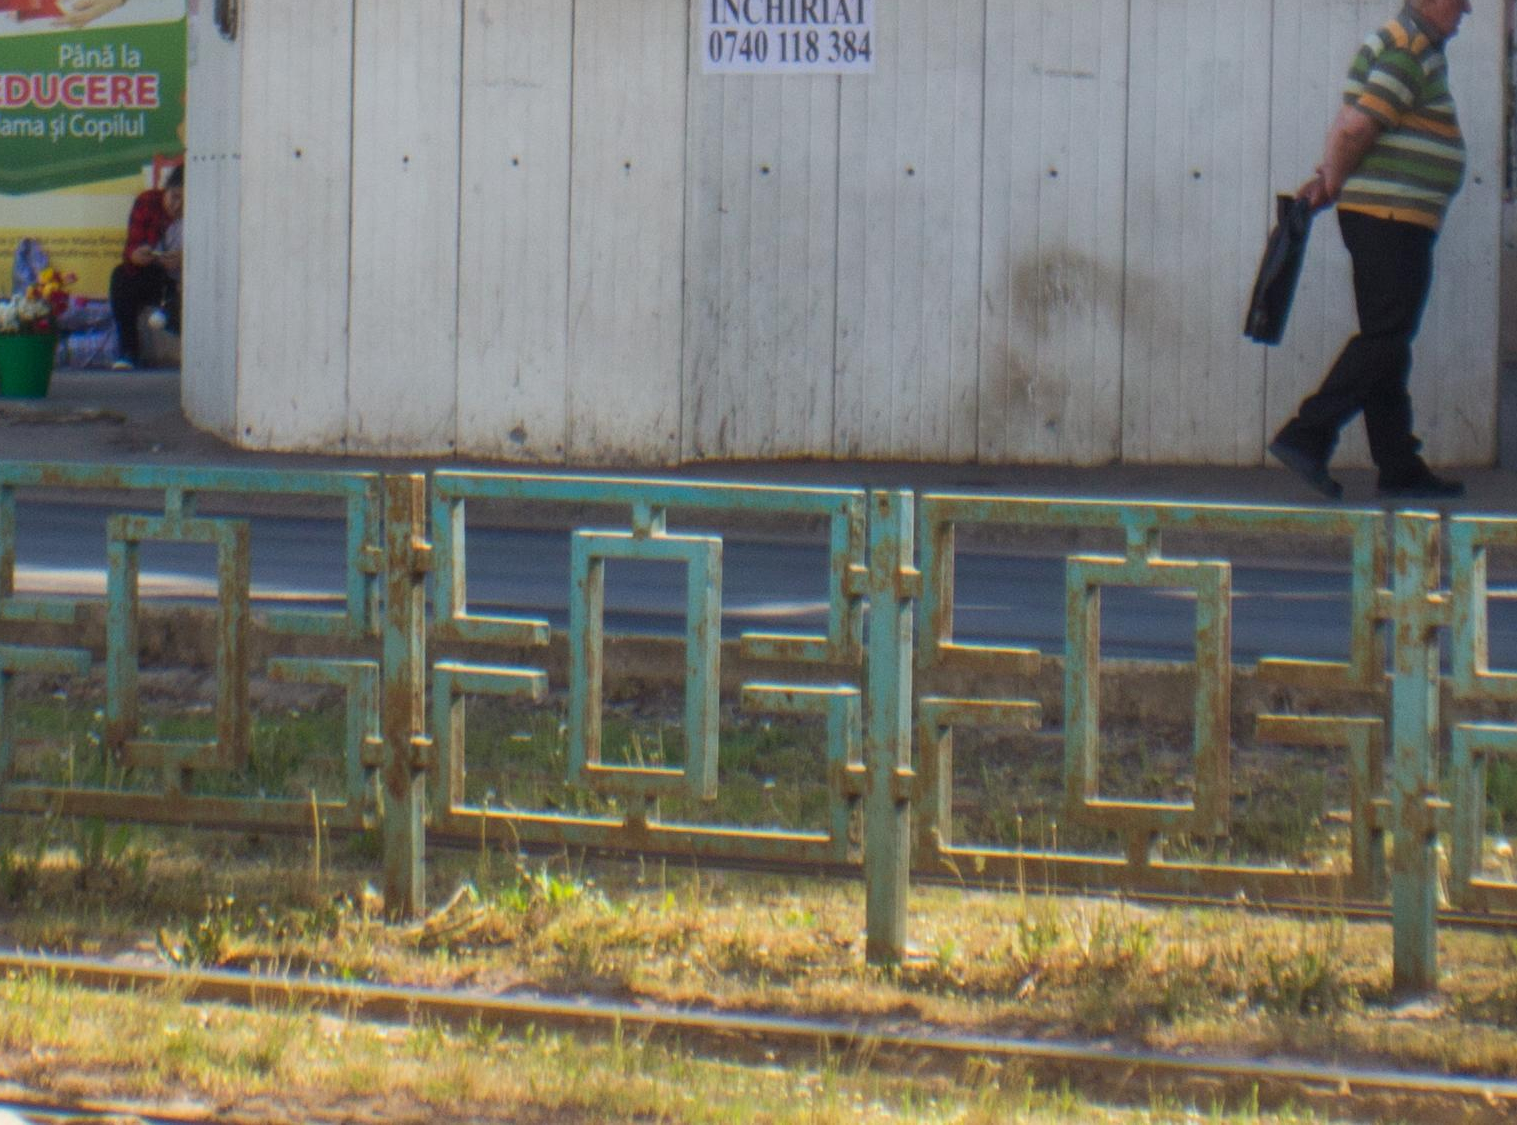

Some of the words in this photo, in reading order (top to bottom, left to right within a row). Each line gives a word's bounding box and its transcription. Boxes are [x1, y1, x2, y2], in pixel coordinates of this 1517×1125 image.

[59, 42, 115, 69] Până
[120, 44, 142, 69] la
[709, 30, 768, 63] 0740
[779, 30, 819, 63] 118
[828, 30, 872, 63] 384
[50, 114, 66, 142] și
[70, 114, 145, 143] Copilul
